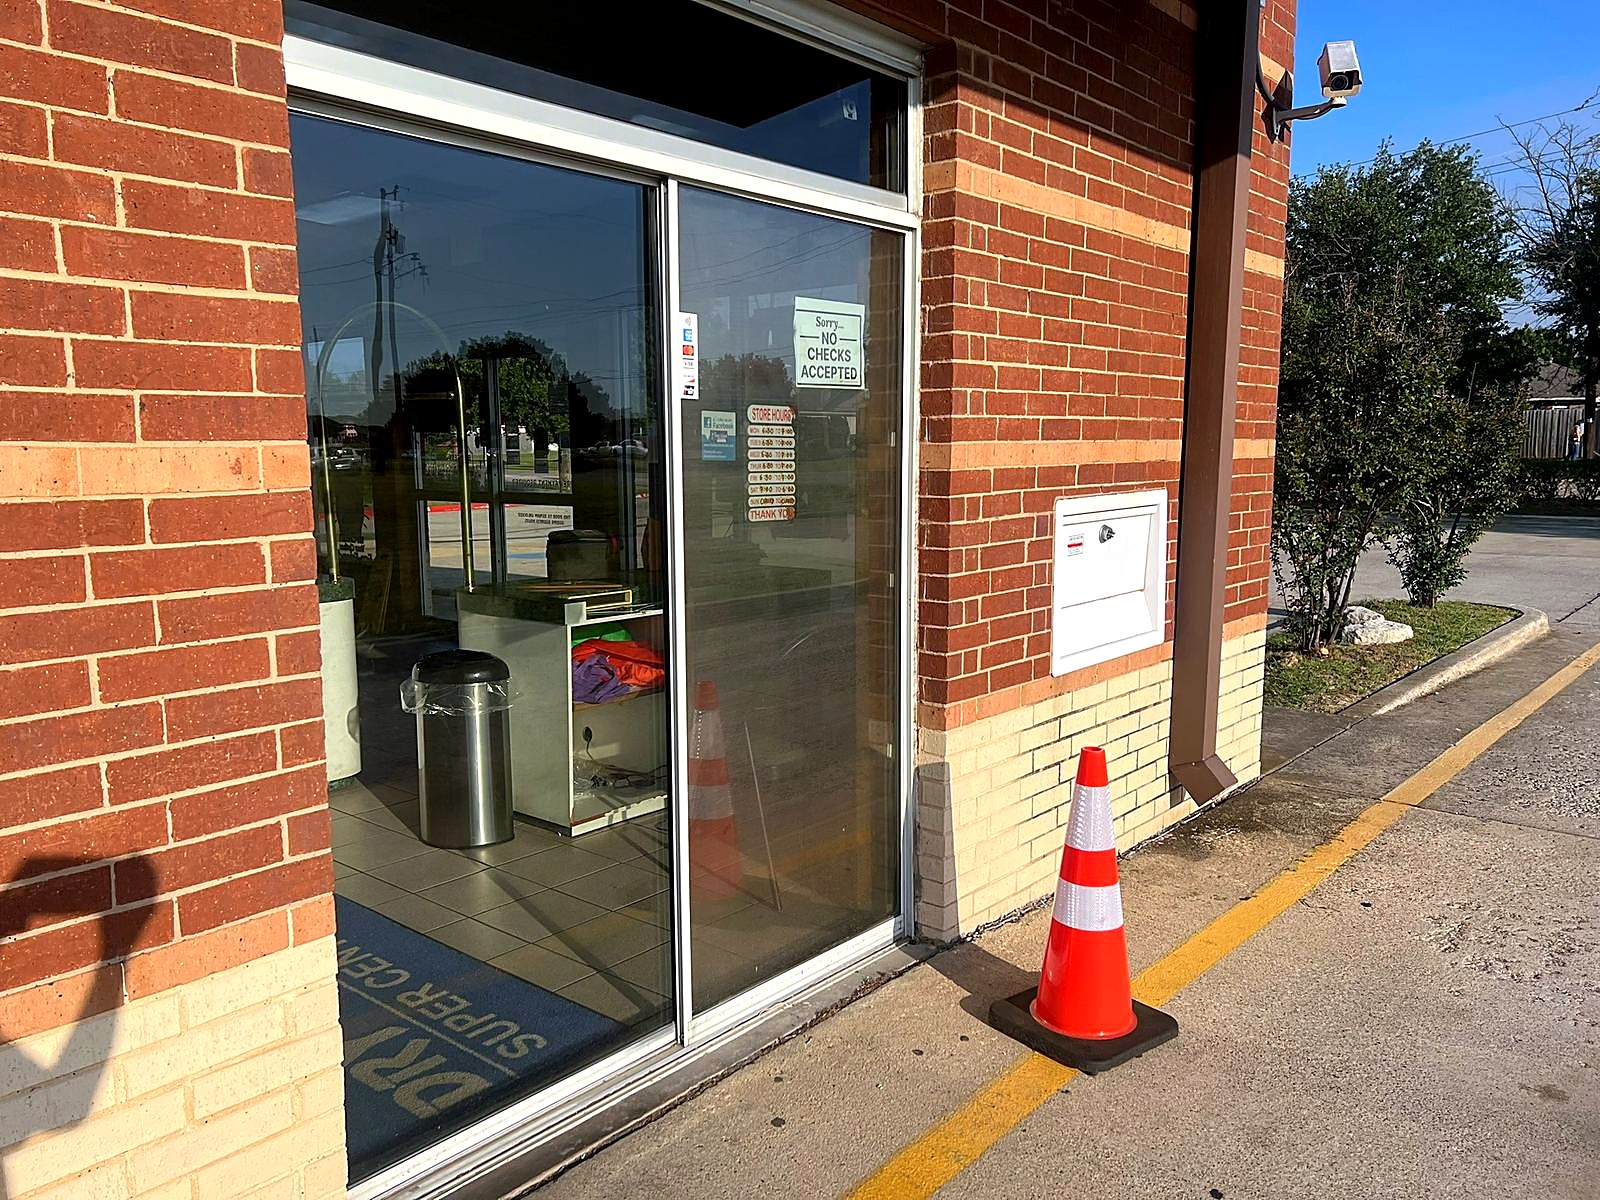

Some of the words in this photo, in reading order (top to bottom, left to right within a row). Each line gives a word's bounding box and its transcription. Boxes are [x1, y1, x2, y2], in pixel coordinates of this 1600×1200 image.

[821, 332, 838, 345] NO
[807, 347, 851, 362] CHECKS
[801, 365, 858, 380] ACCEPTED
[752, 408, 771, 421] STORE
[771, 409, 792, 421] HOURS
[751, 509, 776, 519] THANK
[397, 982, 547, 1059] SUPER
